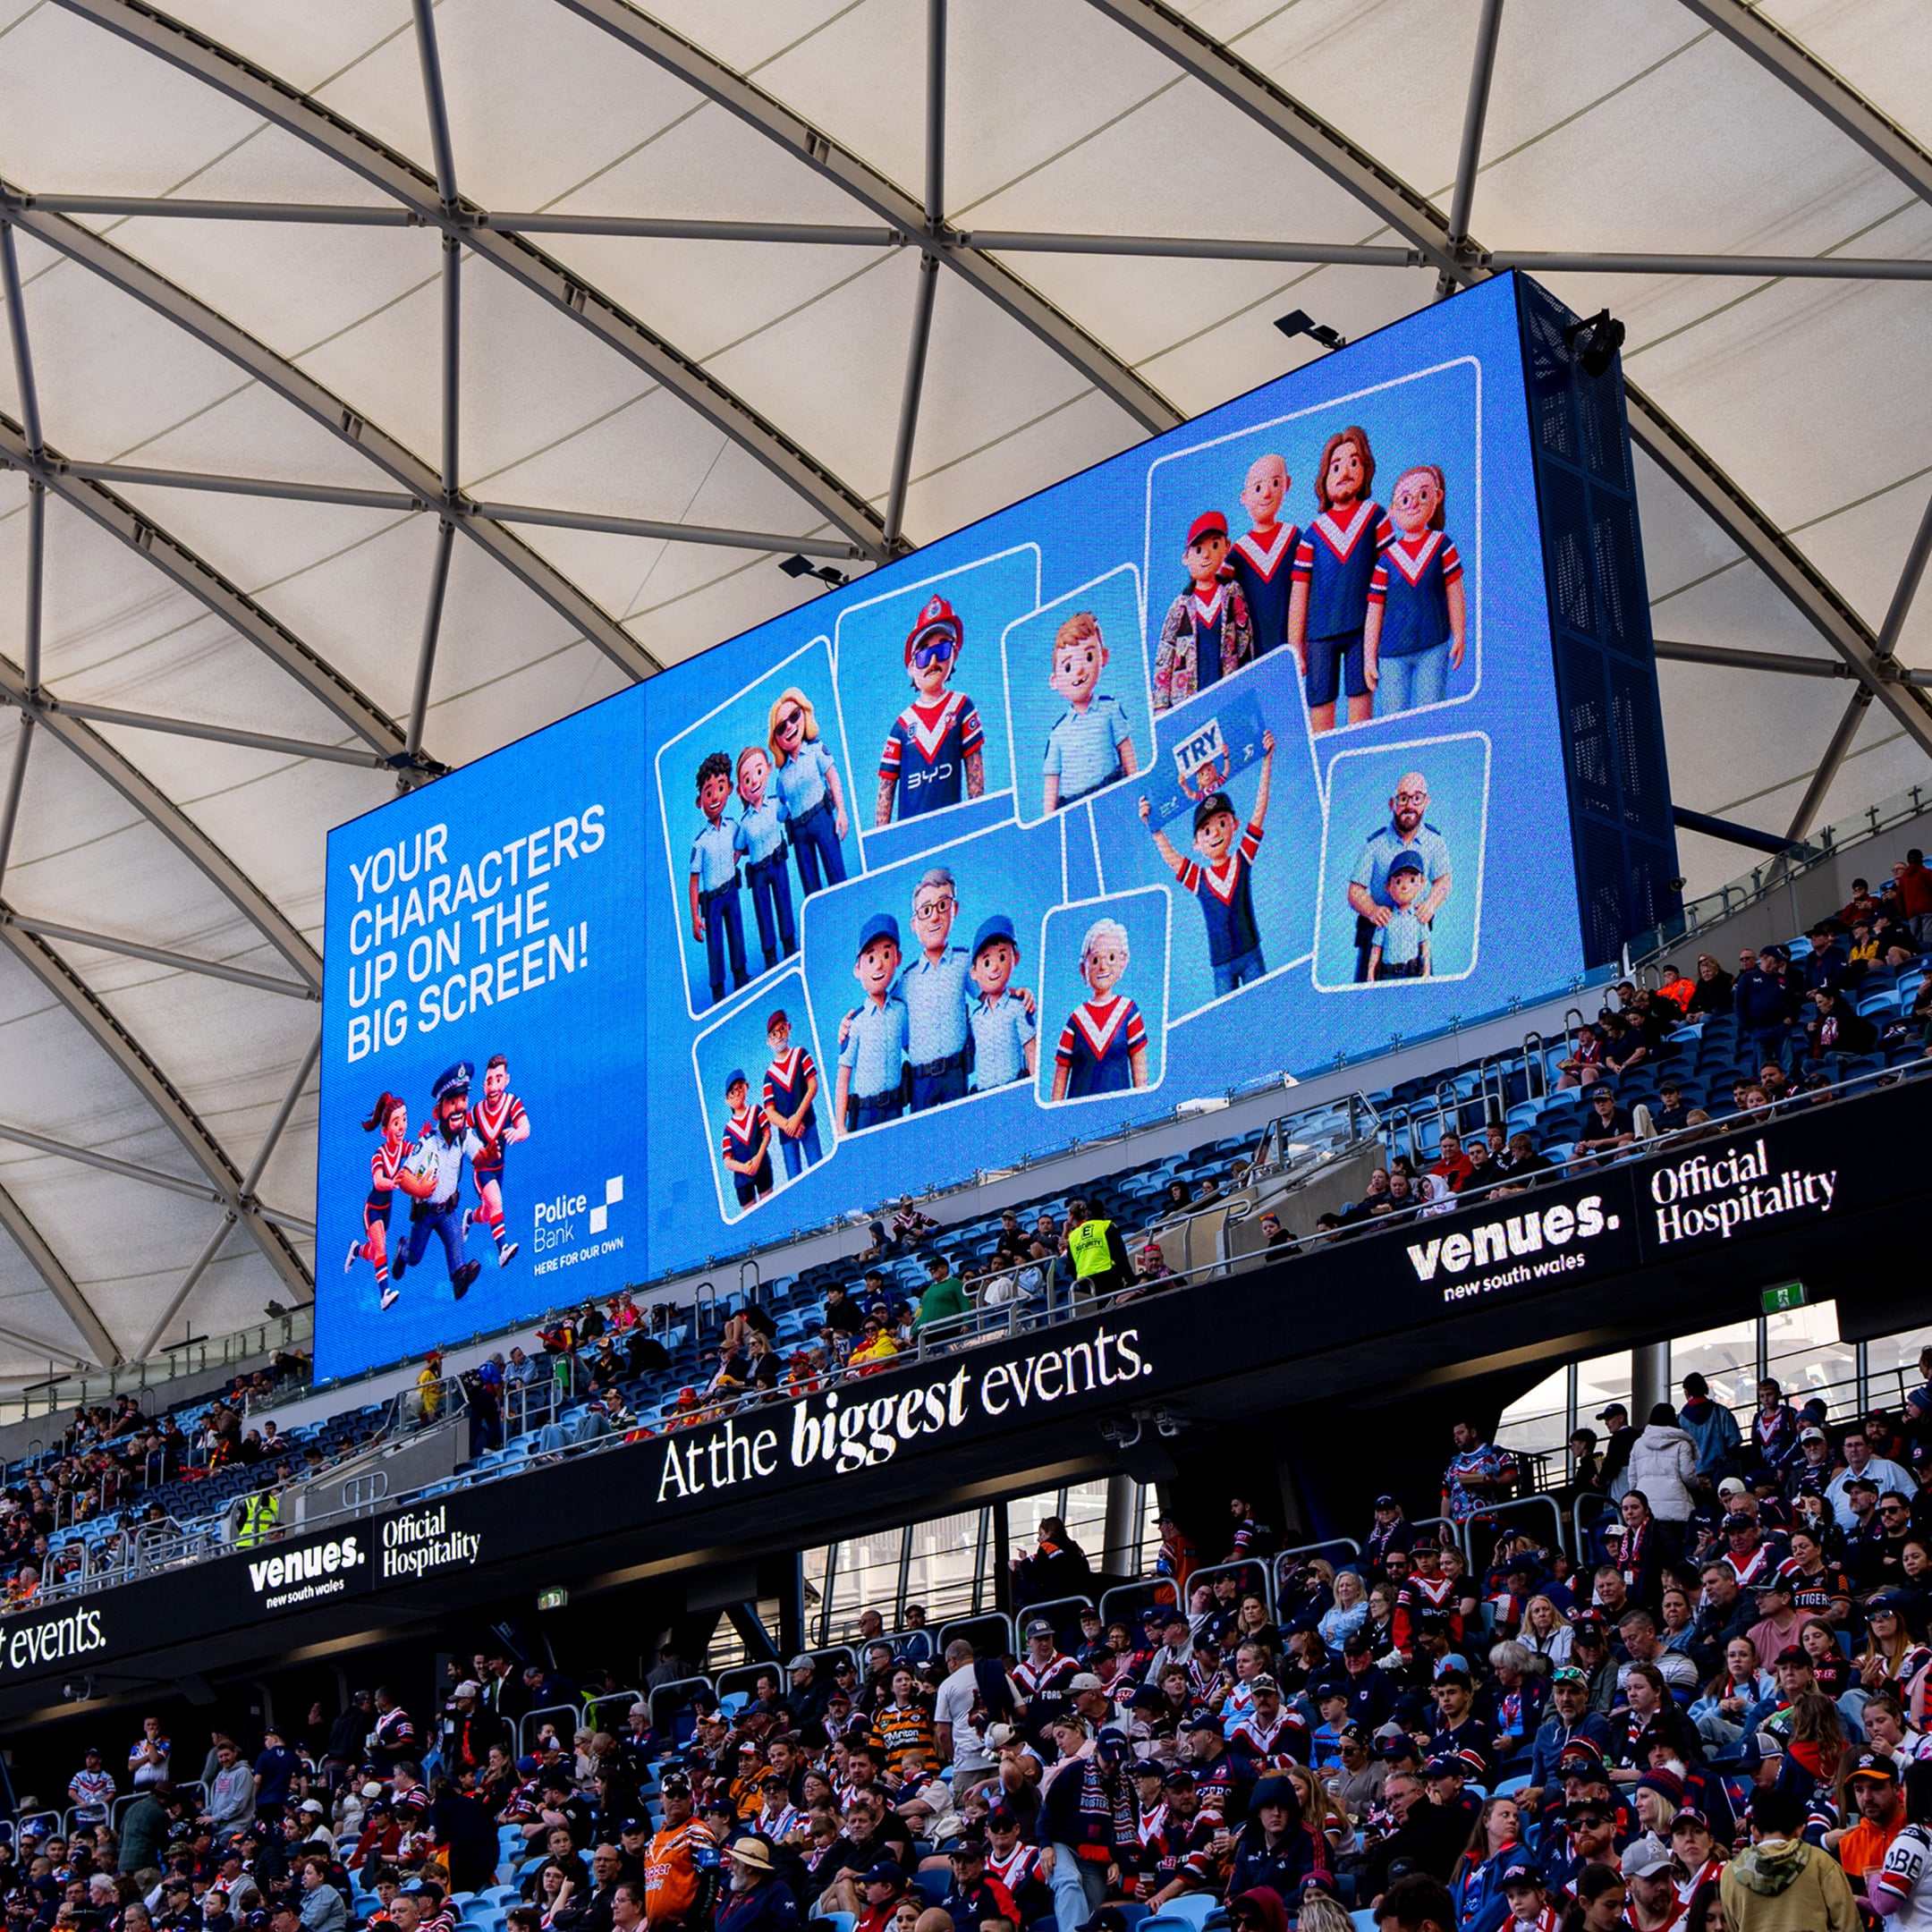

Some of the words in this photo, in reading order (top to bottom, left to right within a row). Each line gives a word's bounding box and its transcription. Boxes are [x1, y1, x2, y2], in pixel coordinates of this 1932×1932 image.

[1176, 725, 1216, 770] TRY
[907, 763, 953, 790] BYD
[349, 823, 448, 902] YOUR
[349, 804, 606, 955] CHARACTERS
[349, 951, 397, 1008] UP
[408, 920, 460, 982] ON
[471, 882, 550, 954] THE
[348, 999, 407, 1063] BIG
[418, 921, 589, 1033] SCREEN!
[1651, 1139, 1769, 1205] Official
[534, 1194, 587, 1228] Police
[1657, 1170, 1837, 1244] Hospitality
[534, 1219, 574, 1253] Bank
[534, 1258, 558, 1276] HERE
[560, 1251, 579, 1268] FOR
[580, 1244, 600, 1261] OUR
[601, 1236, 624, 1255] OWN
[1407, 1195, 1621, 1282] venues.
[1444, 1279, 1481, 1302] new
[1484, 1259, 1531, 1292] south
[1532, 1252, 1586, 1279] wales
[657, 1439, 706, 1503] At
[709, 1419, 777, 1487] the
[791, 1363, 970, 1473] biggest
[981, 1326, 1153, 1415] events.
[383, 1505, 446, 1548] Official
[383, 1531, 480, 1578] Hospitality
[249, 1536, 365, 1592] venues.
[267, 1596, 286, 1609] new
[287, 1583, 315, 1606] south
[315, 1578, 344, 1598] wales
[10, 1606, 106, 1669] events.
